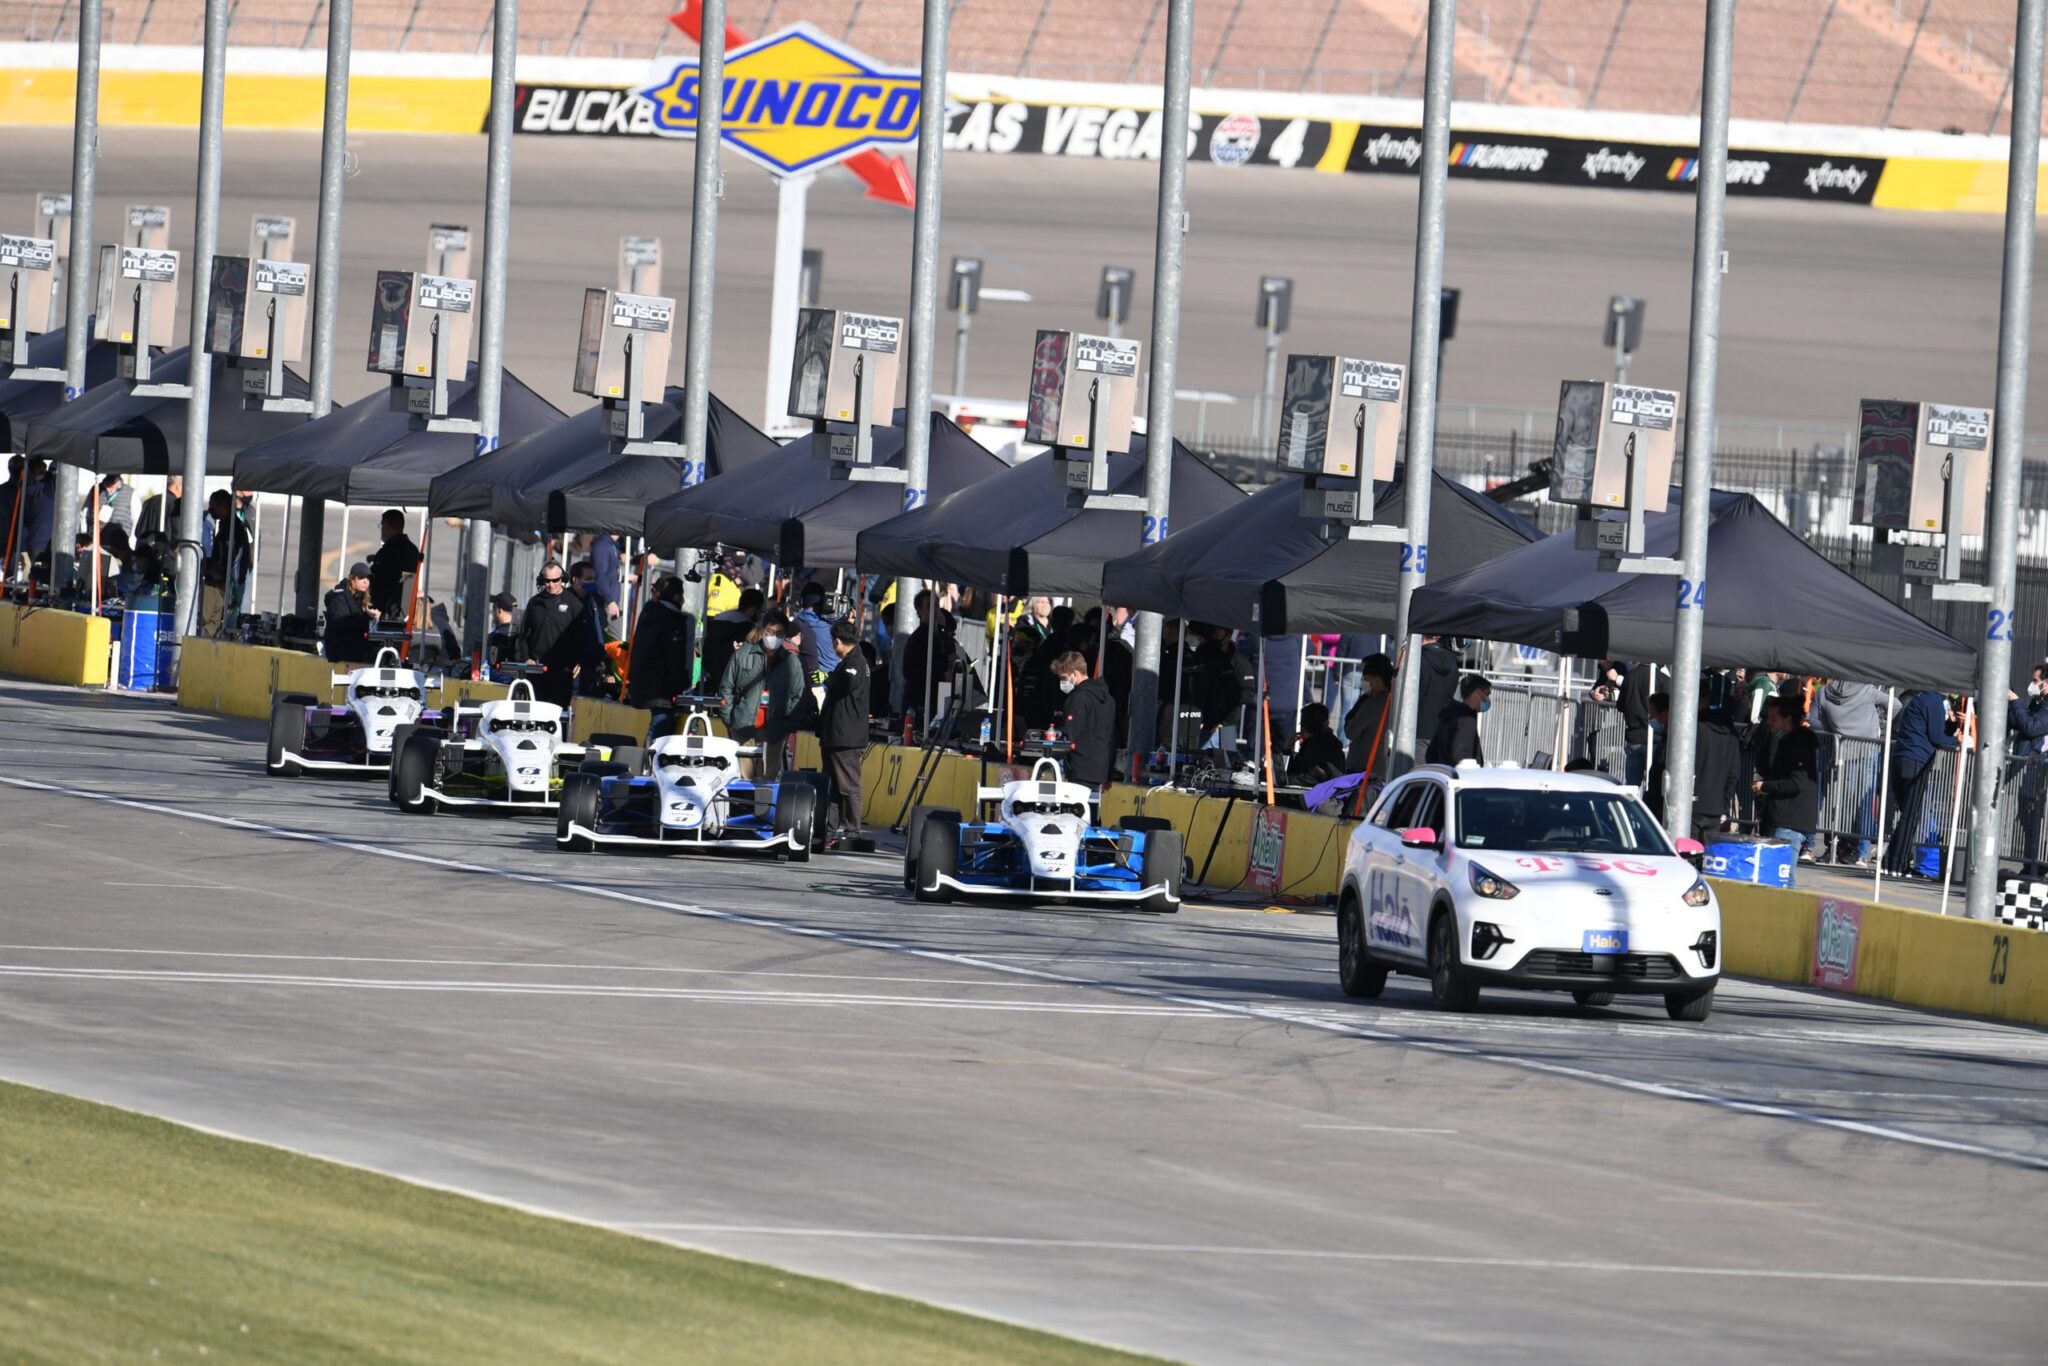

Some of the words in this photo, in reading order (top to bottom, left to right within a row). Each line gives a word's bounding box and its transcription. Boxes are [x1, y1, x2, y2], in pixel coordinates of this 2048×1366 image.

[667, 75, 921, 131] SUNOCO
[1581, 147, 1646, 182] xfinity
[1804, 161, 1868, 194] xfinity
